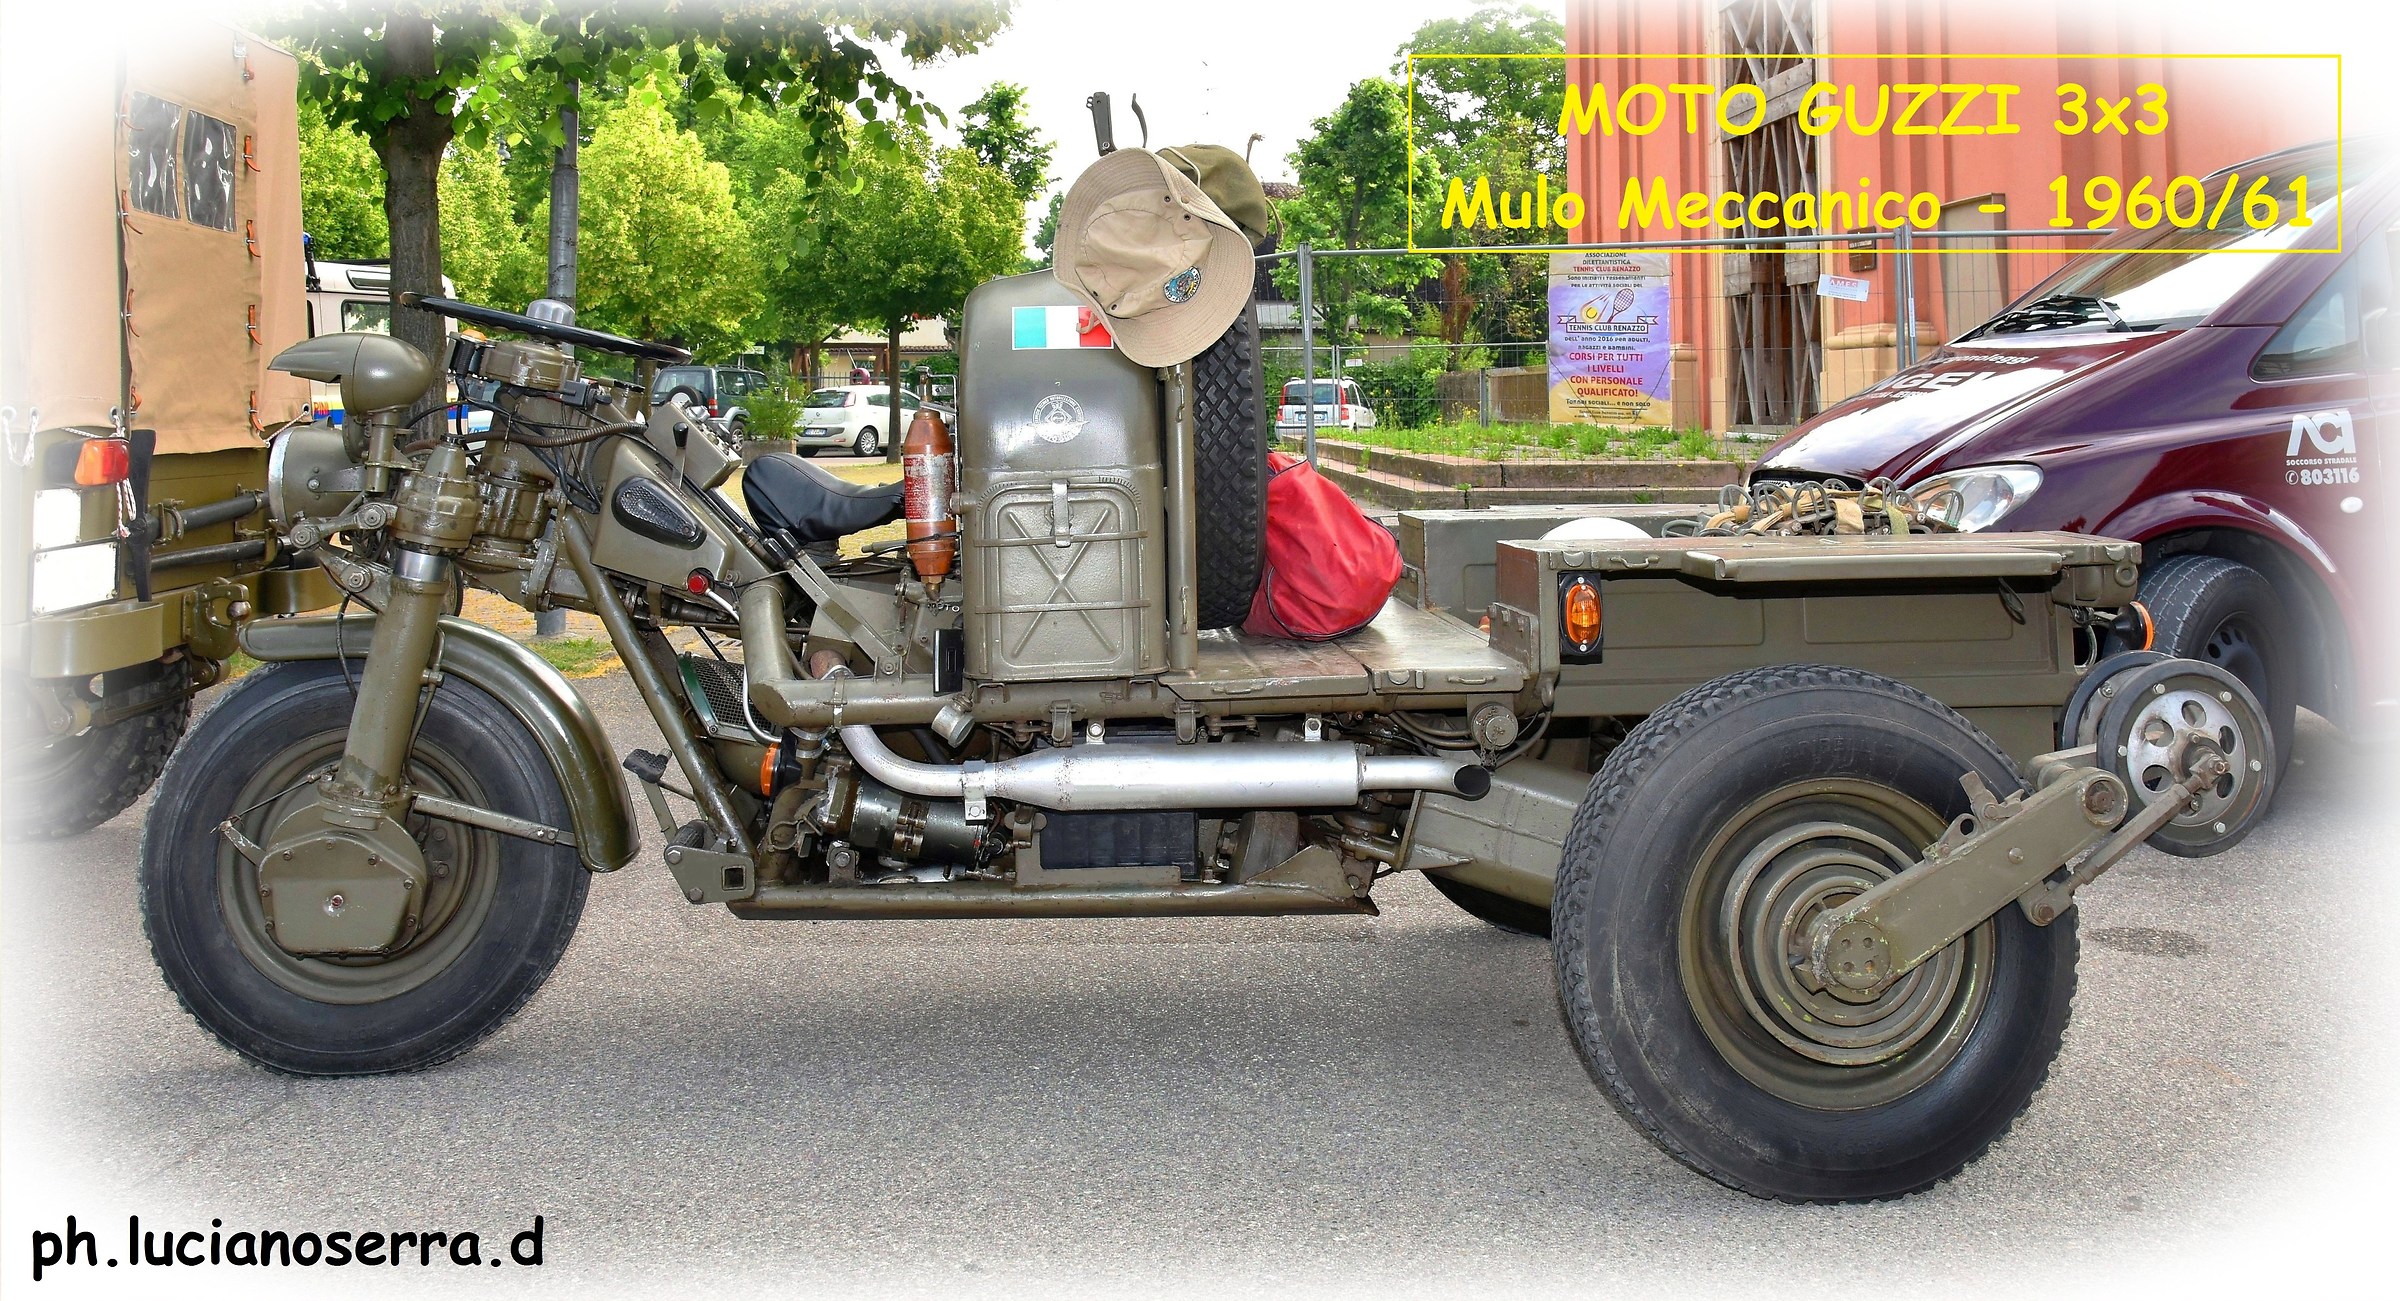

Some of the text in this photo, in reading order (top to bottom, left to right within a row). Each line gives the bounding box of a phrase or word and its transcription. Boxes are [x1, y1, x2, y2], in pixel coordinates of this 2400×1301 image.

[1613, 324, 1646, 332] RENAZZO
[1569, 352, 1643, 362] CORSI PER TUTTI
[1592, 365, 1624, 373] LIVELLI
[1570, 375, 1643, 385] CON PERSONALE
[1577, 387, 1638, 397] QUALIFICATO!
[2286, 457, 2357, 466] SOCCORSO STRADALE
[2300, 467, 2360, 486] 803116
